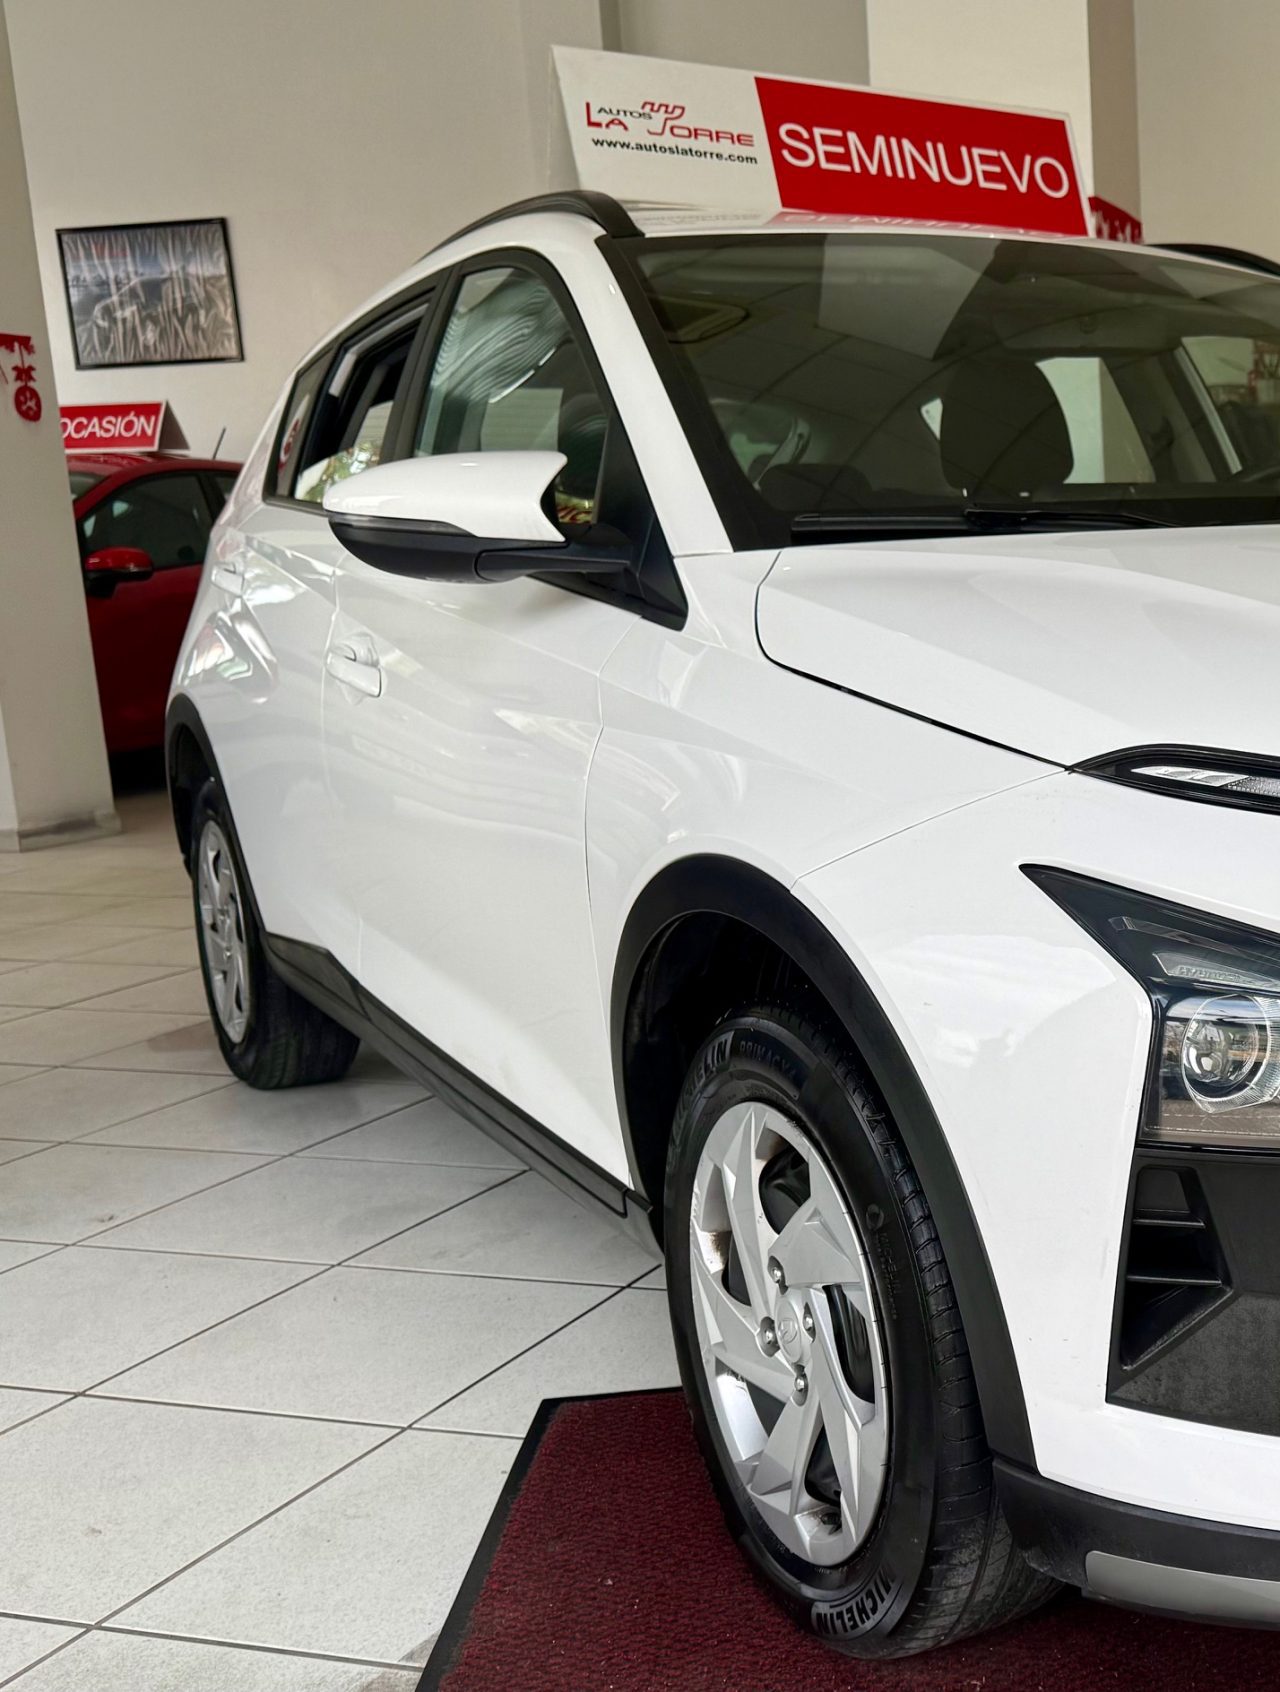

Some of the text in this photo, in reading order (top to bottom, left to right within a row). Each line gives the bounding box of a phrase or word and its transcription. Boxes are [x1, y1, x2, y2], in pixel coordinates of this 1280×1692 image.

[586, 101, 629, 132] LA
[597, 107, 653, 120] AUTOS
[592, 137, 758, 165] www.autoslatorre.com
[778, 123, 1070, 199] SEMINUEVO
